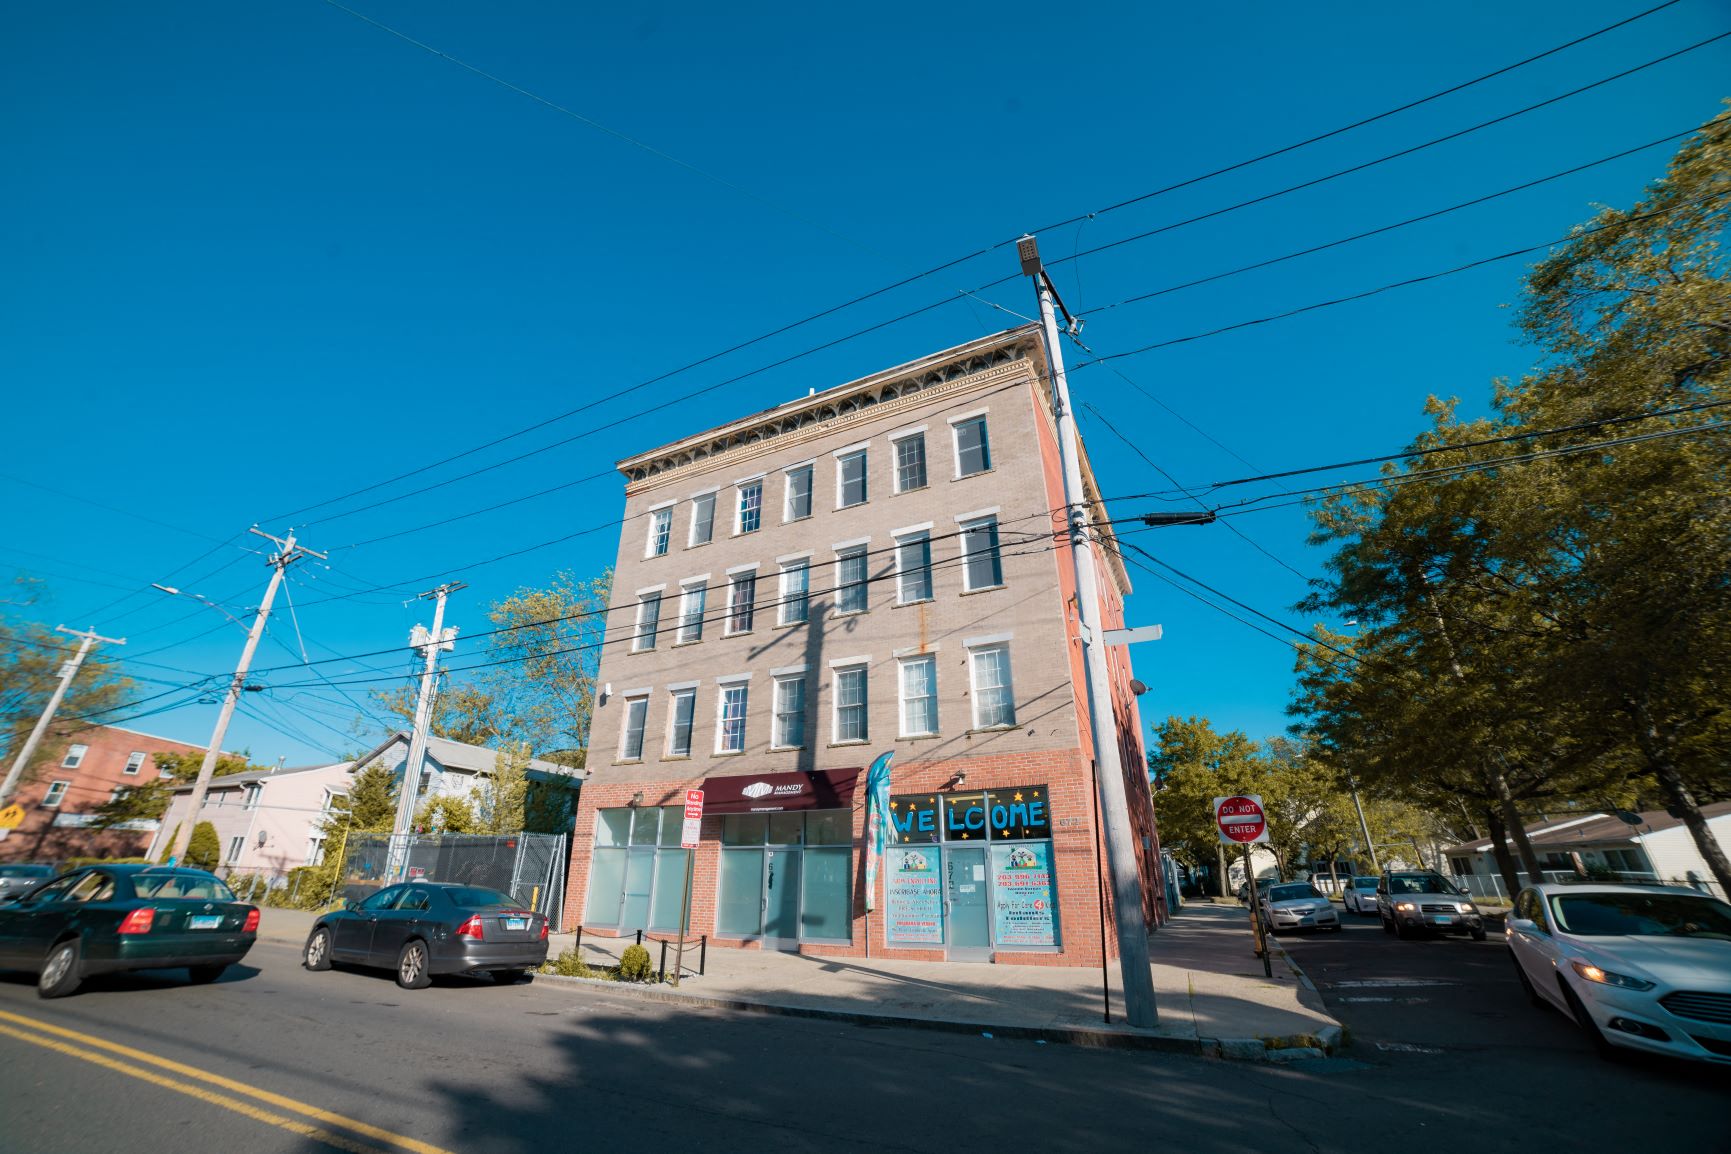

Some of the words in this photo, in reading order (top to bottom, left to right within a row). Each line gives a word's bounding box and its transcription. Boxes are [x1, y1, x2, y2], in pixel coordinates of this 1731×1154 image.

[775, 783, 804, 792] MANDY
[690, 792, 699, 800] No
[1222, 806, 1234, 814] DO
[1239, 804, 1255, 813] NOT
[1229, 825, 1257, 834] ENTER
